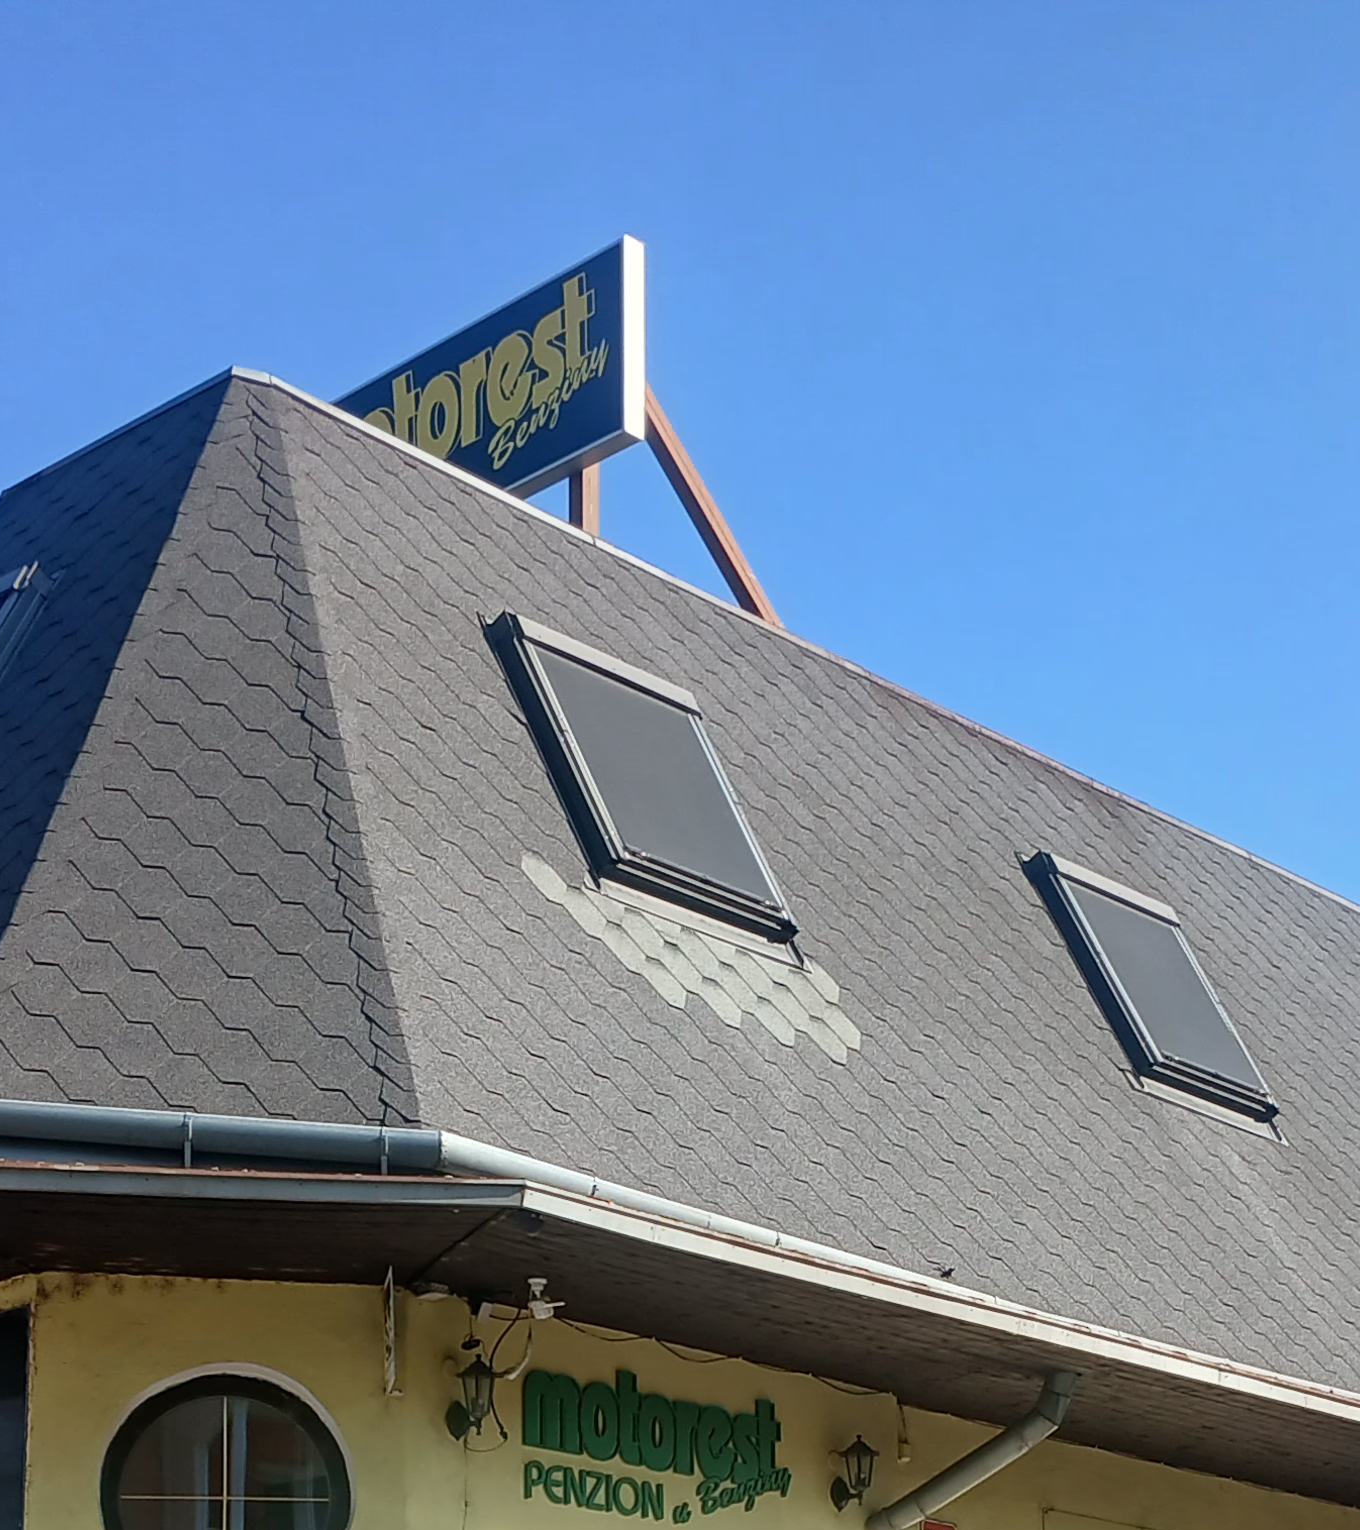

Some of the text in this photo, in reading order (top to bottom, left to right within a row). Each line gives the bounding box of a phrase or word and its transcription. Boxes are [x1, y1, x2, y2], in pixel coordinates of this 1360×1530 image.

[362, 272, 595, 459] torest
[488, 338, 610, 470] Benziny
[522, 1369, 781, 1482] motorest
[524, 1460, 664, 1521] PENZION
[695, 1466, 792, 1516] Benziny
